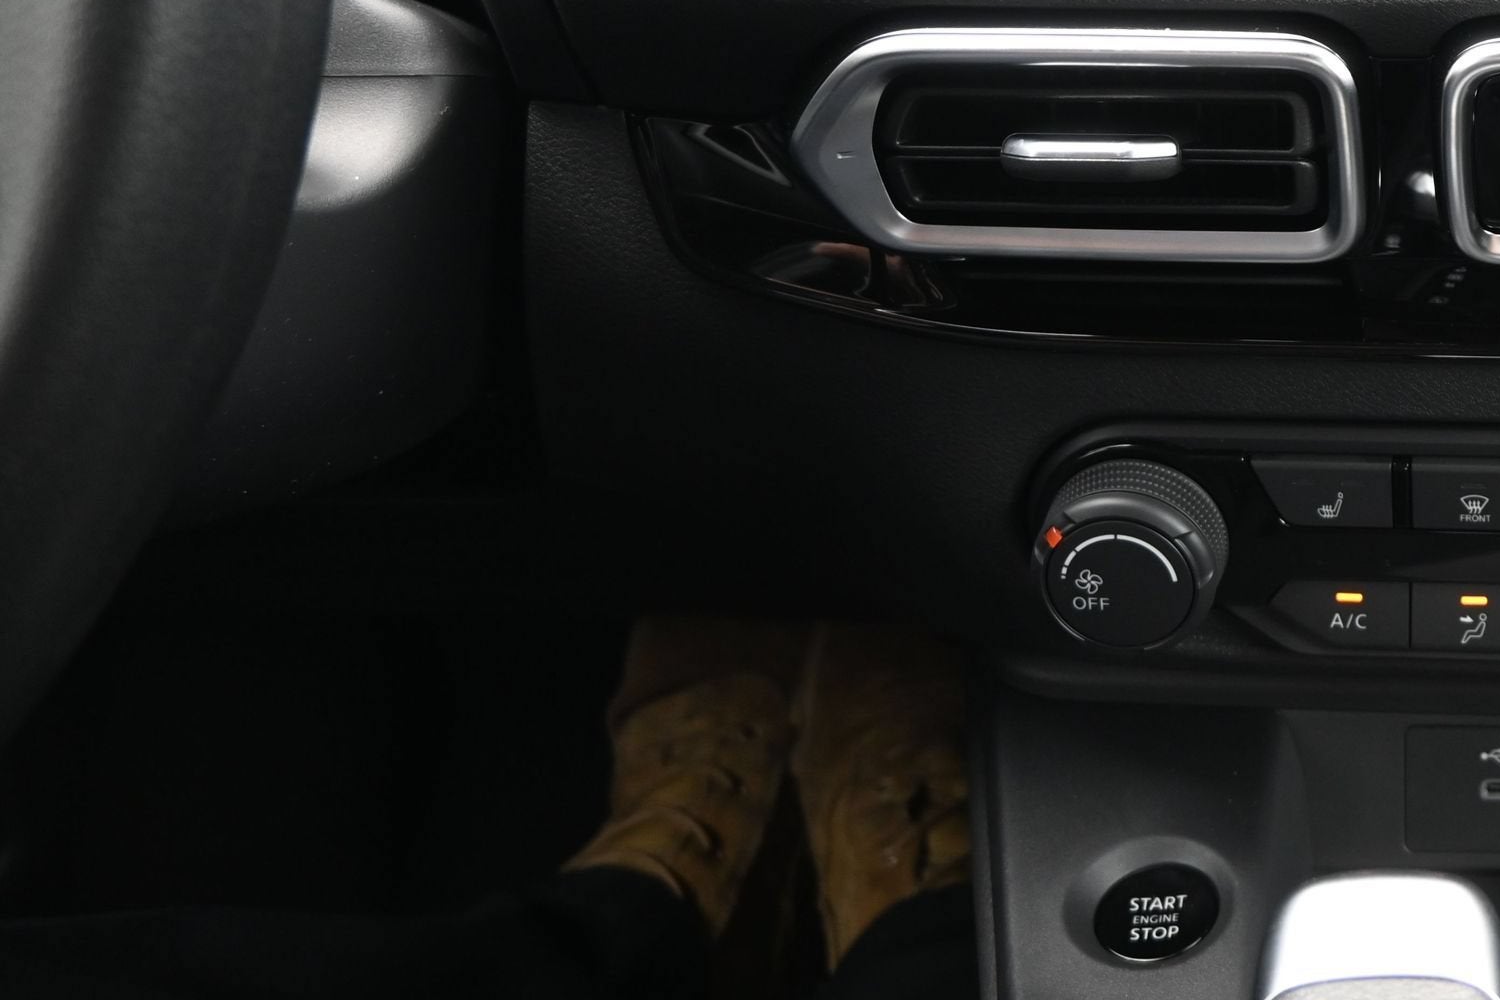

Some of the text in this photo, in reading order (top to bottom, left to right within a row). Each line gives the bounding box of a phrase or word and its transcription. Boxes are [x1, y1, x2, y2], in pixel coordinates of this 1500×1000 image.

[1459, 513, 1491, 523] FRONT
[1072, 595, 1110, 611] OFF
[1330, 613, 1367, 630] A/C
[1129, 893, 1188, 912] START
[1132, 912, 1180, 925] ENGINE
[1129, 925, 1180, 941] STOP
